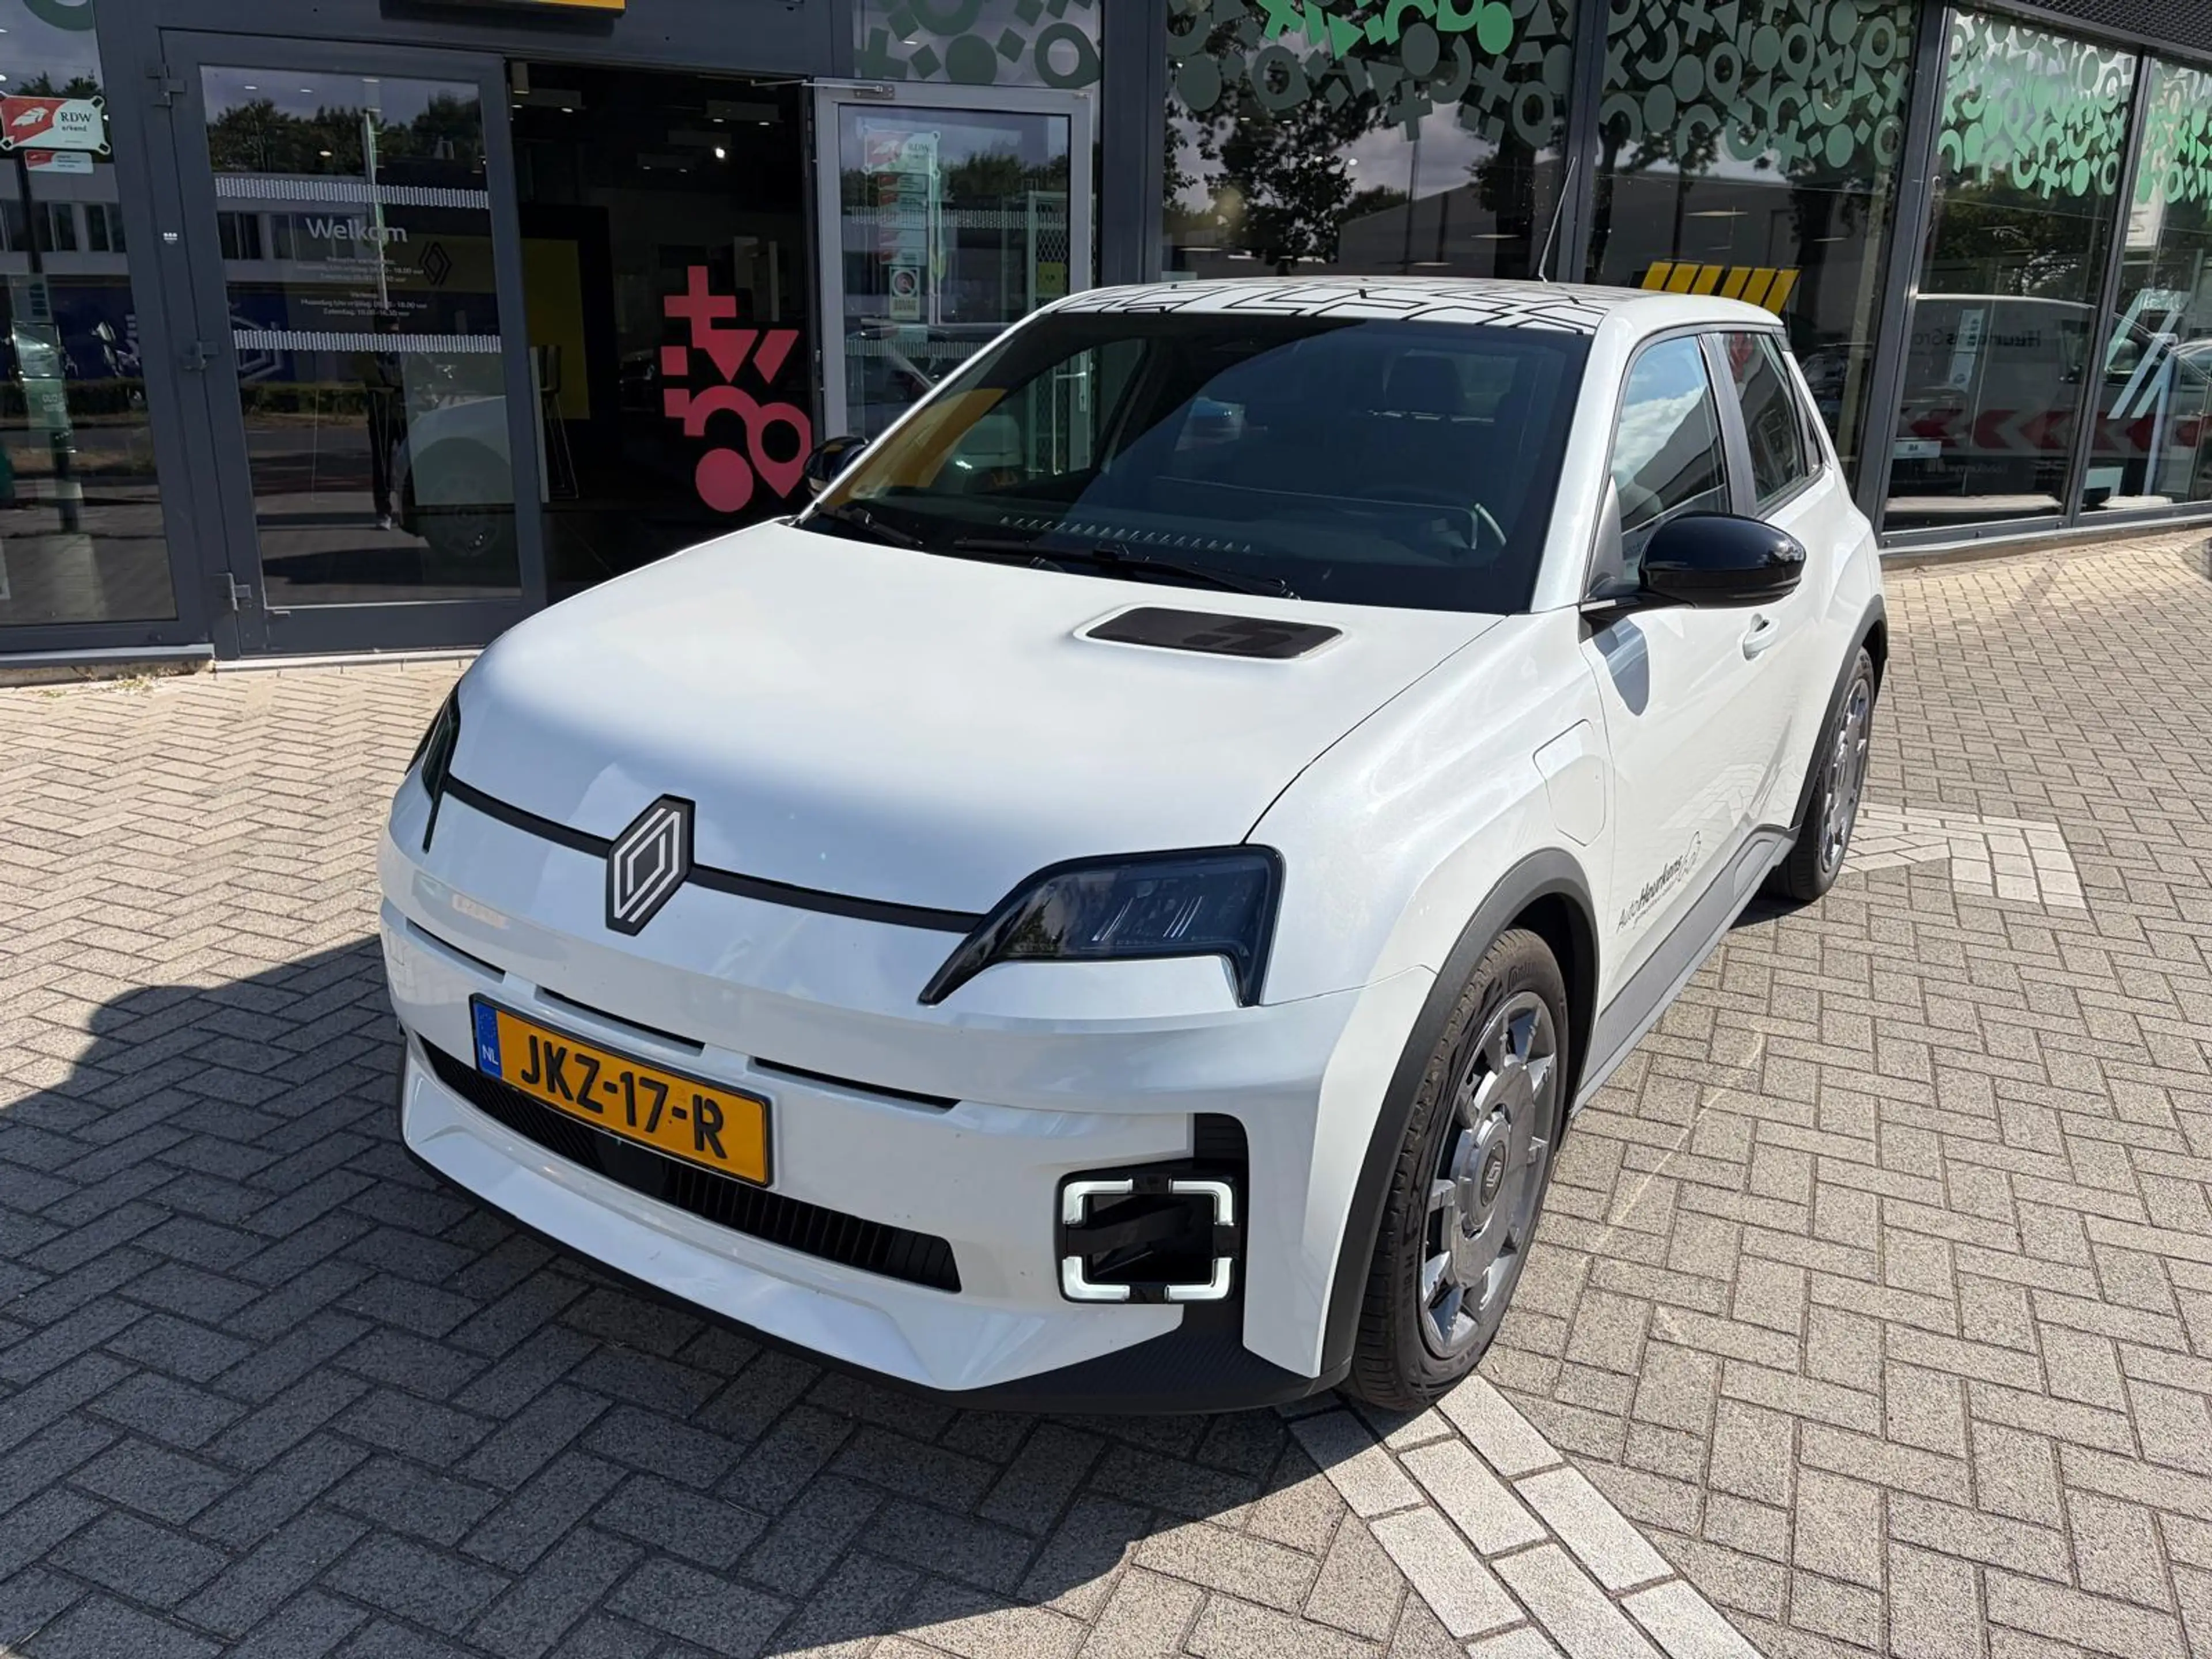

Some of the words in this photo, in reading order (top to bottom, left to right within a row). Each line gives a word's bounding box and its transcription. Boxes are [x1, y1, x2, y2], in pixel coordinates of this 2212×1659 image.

[60, 111, 92, 123] RDW
[305, 216, 408, 243] Welkom
[481, 1044, 499, 1066] NL
[520, 1033, 728, 1160] JKZ-17-R
